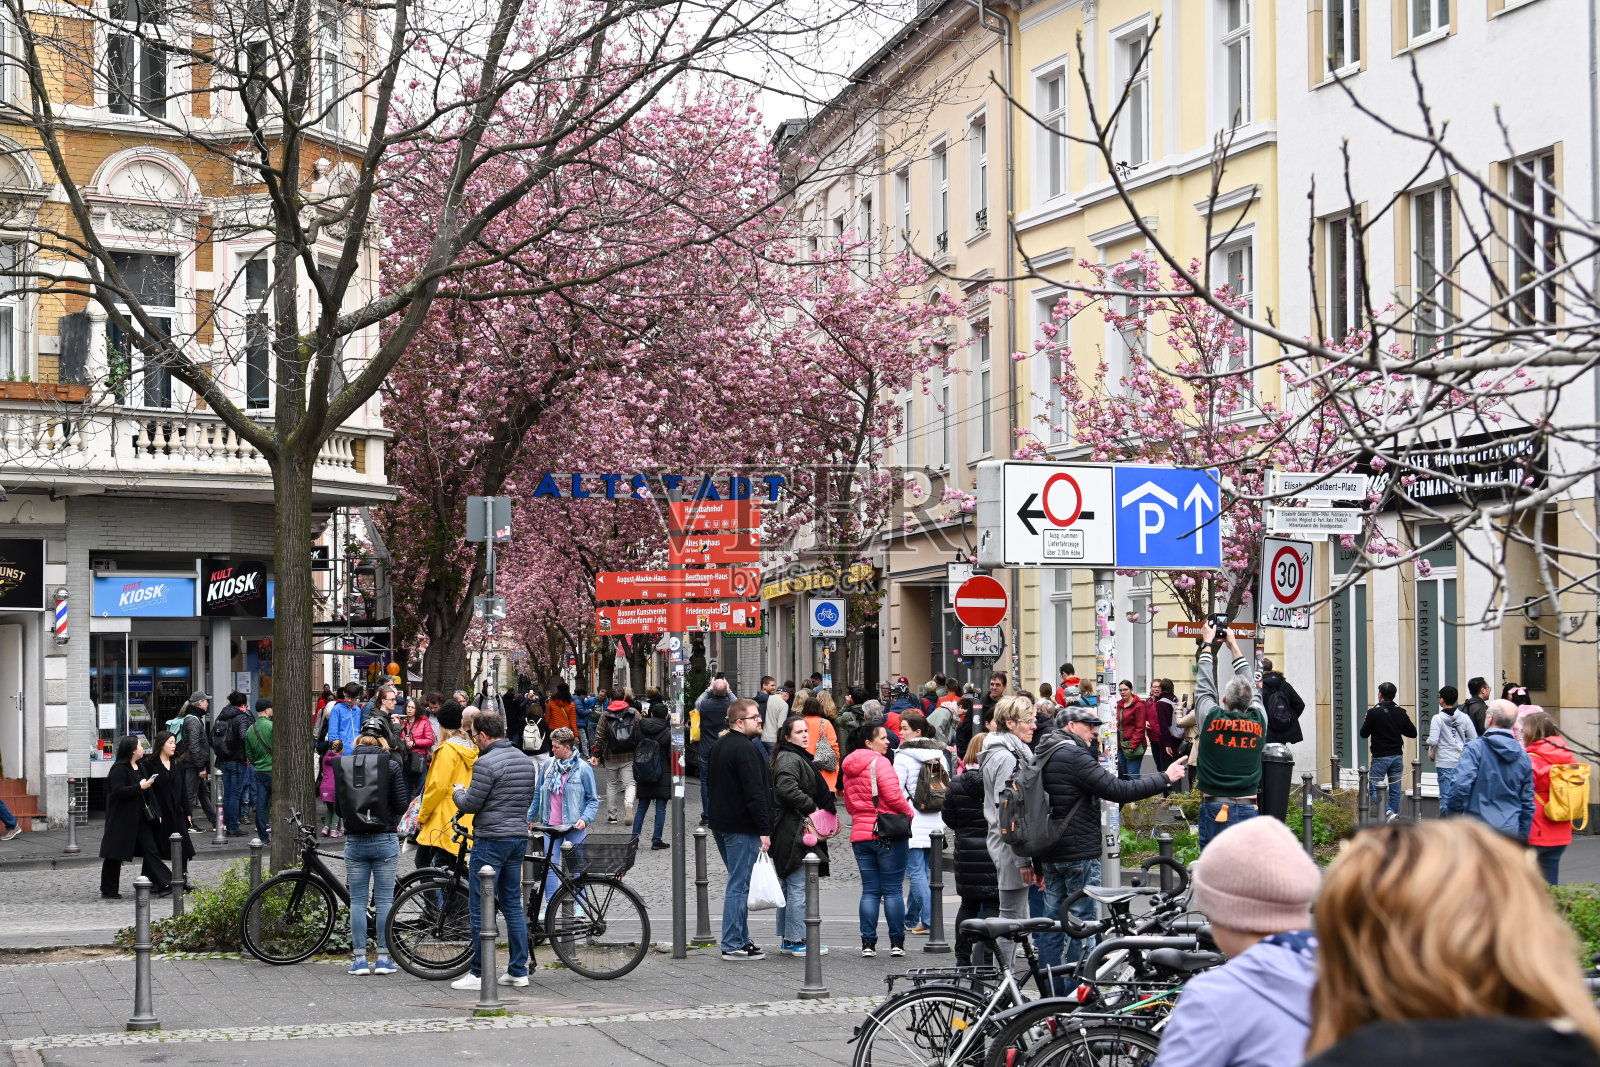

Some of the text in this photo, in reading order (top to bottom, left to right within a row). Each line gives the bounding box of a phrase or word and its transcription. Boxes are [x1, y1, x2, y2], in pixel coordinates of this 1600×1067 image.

[533, 471, 785, 501] ALTSTADT
[1284, 481, 1357, 492] Elisab-Selbert-Platz
[684, 504, 723, 514] Hauptbahnhof
[1139, 502, 1165, 554] P
[685, 539, 698, 547] Altes
[210, 567, 233, 582] KULT
[616, 574, 667, 584] August-Macke-Haus
[685, 573, 728, 581] Beethoven-Haus
[1277, 562, 1297, 589] 30
[122, 581, 143, 593] KULT
[206, 571, 258, 603] KIOSK
[119, 583, 165, 607] KIOSK
[617, 608, 667, 617] Bonner Kunstverein
[685, 606, 720, 614] Friedensplatz
[617, 616, 653, 624] Künstlerforum
[1419, 600, 1429, 683] PERMANENT
[1206, 718, 1263, 738] SUPERDRY
